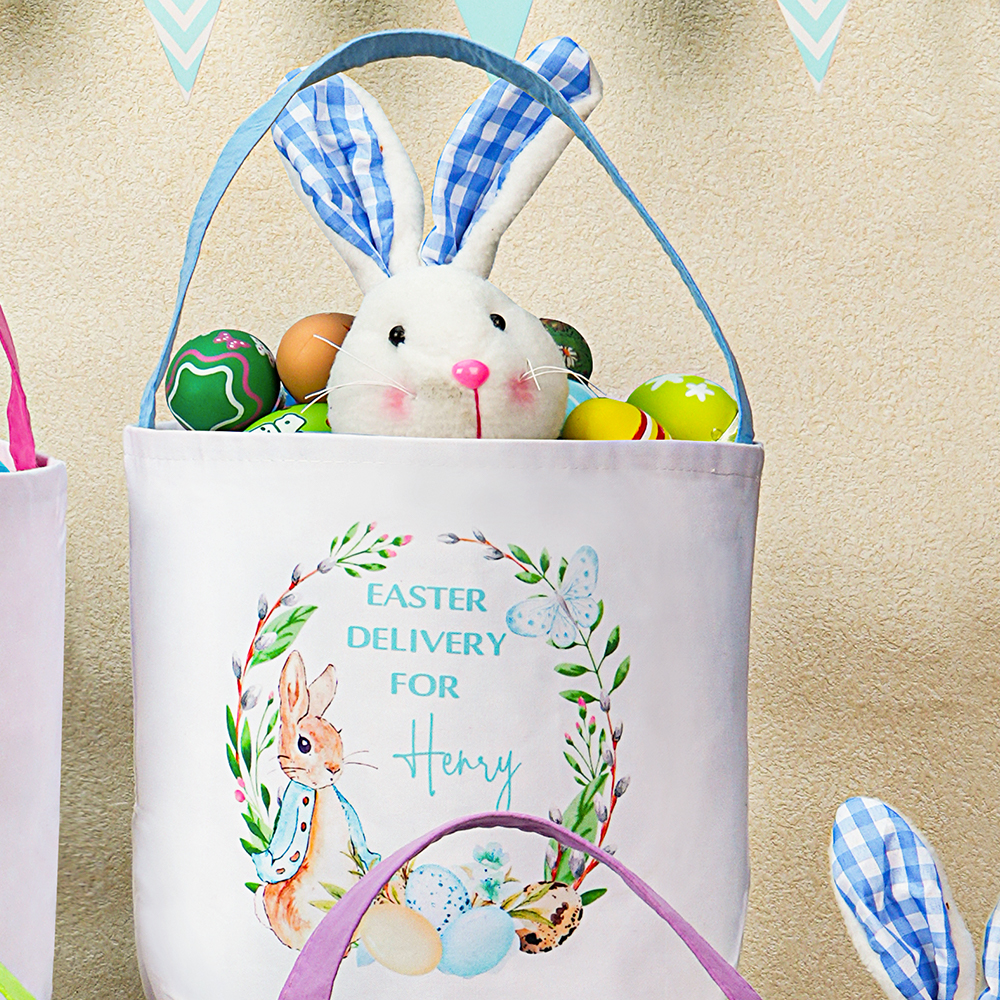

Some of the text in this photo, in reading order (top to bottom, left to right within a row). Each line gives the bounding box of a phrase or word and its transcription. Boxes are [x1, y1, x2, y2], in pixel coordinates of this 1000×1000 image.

[366, 582, 488, 613] EASTER
[347, 625, 507, 656] DELIVERY
[390, 672, 460, 699] FOR
[393, 712, 522, 811] Henry
